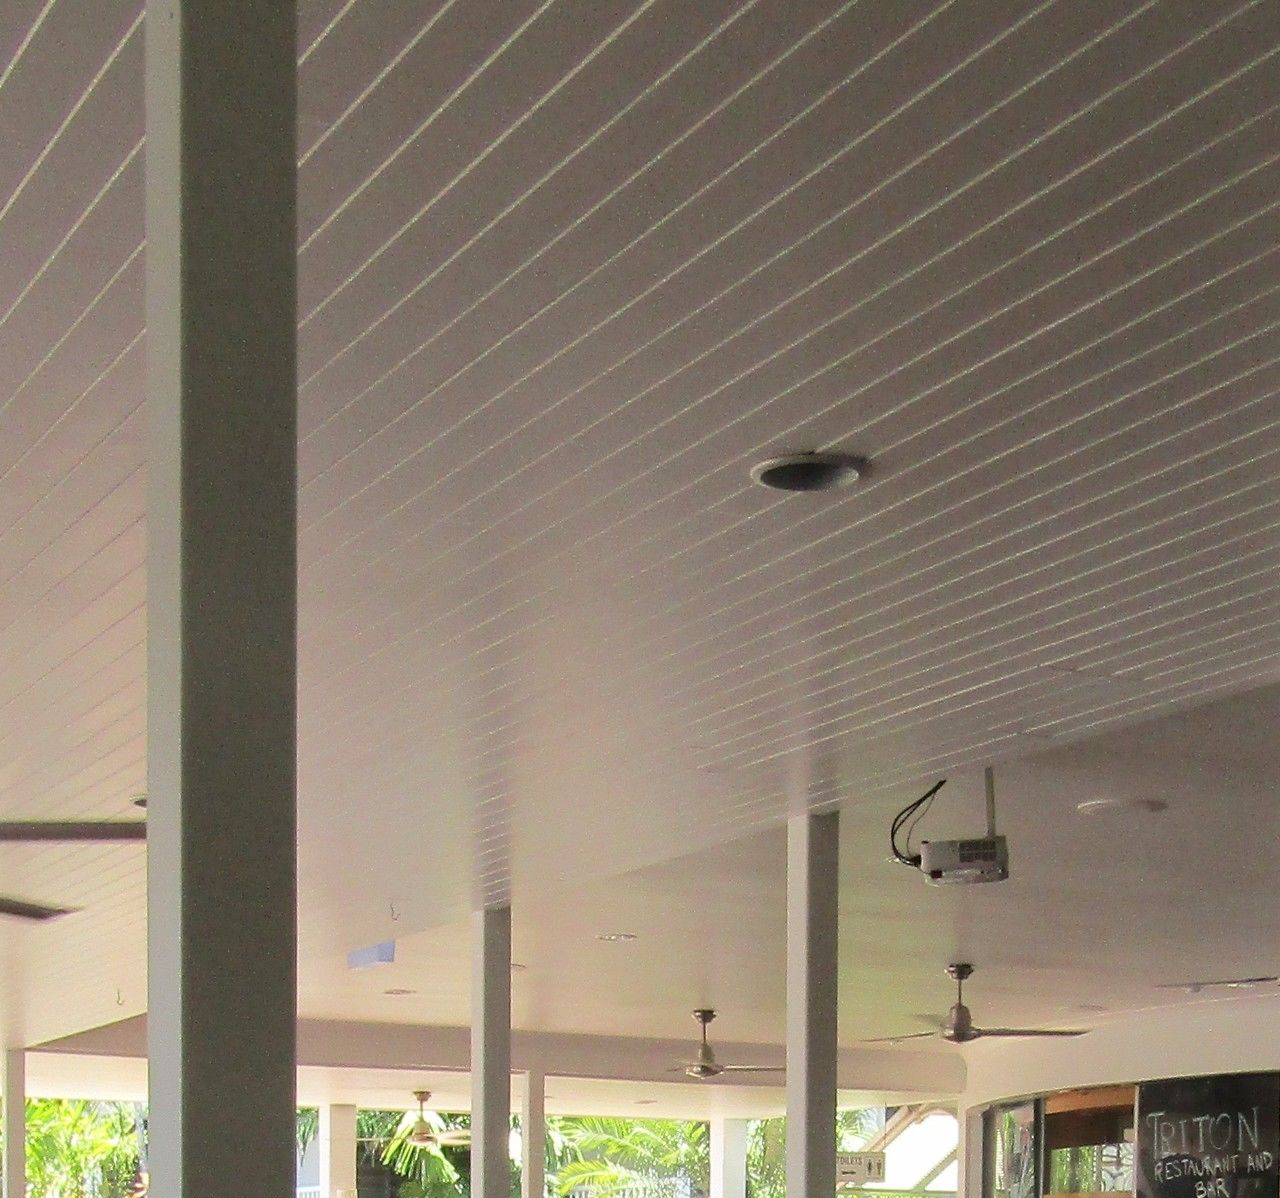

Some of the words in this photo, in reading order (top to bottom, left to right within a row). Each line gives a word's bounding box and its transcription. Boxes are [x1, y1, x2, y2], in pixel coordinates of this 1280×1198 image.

[1146, 1107, 1258, 1160] TRITON
[1154, 1154, 1239, 1183] RESTAURANT
[1247, 1151, 1273, 1173] AND
[1194, 1178, 1230, 1198] BAR
